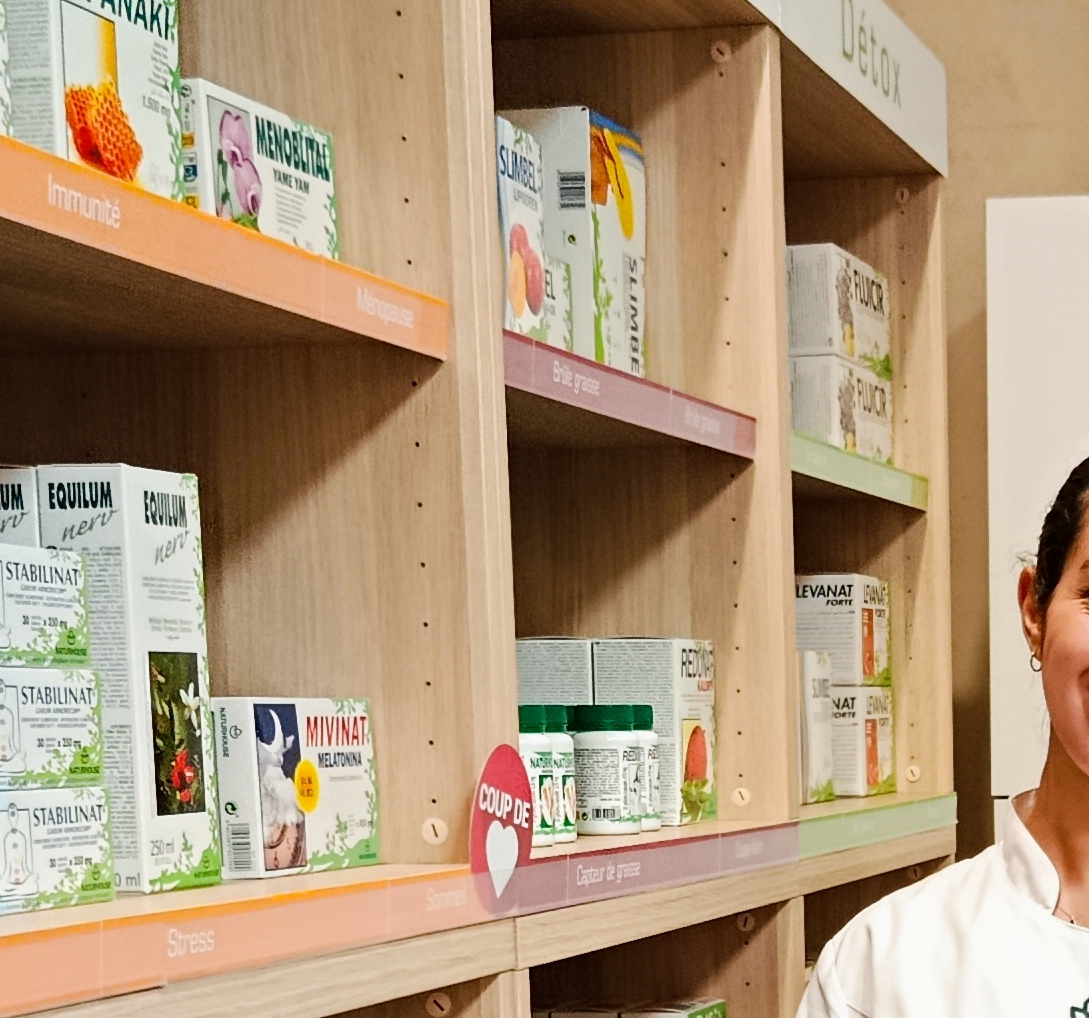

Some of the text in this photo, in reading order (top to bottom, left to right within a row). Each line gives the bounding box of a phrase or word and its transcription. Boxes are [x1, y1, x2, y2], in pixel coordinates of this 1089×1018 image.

[842, 0, 901, 109] Détox
[273, 168, 309, 194] YAME YAM
[500, 145, 537, 194] SLIMBEL
[47, 173, 121, 229] Immunité
[628, 257, 641, 374] SLIMBE
[48, 482, 112, 510] EQUILUM
[143, 490, 187, 528] EQUILUM
[62, 509, 120, 542] nerv
[154, 530, 190, 566] nerv
[5, 561, 79, 587] STABILINAT
[796, 584, 854, 599] LEVANAT
[21, 686, 93, 706] STABILINAT
[306, 716, 367, 747] MIVINAT
[318, 752, 362, 768] MELATONINA
[33, 804, 102, 826] STABILINAT
[479, 783, 532, 829] COUP DE
[150, 839, 175, 856] 250 ml
[125, 873, 141, 888] ml
[576, 861, 641, 889] Capteur de graisse
[168, 928, 214, 958] Stress
